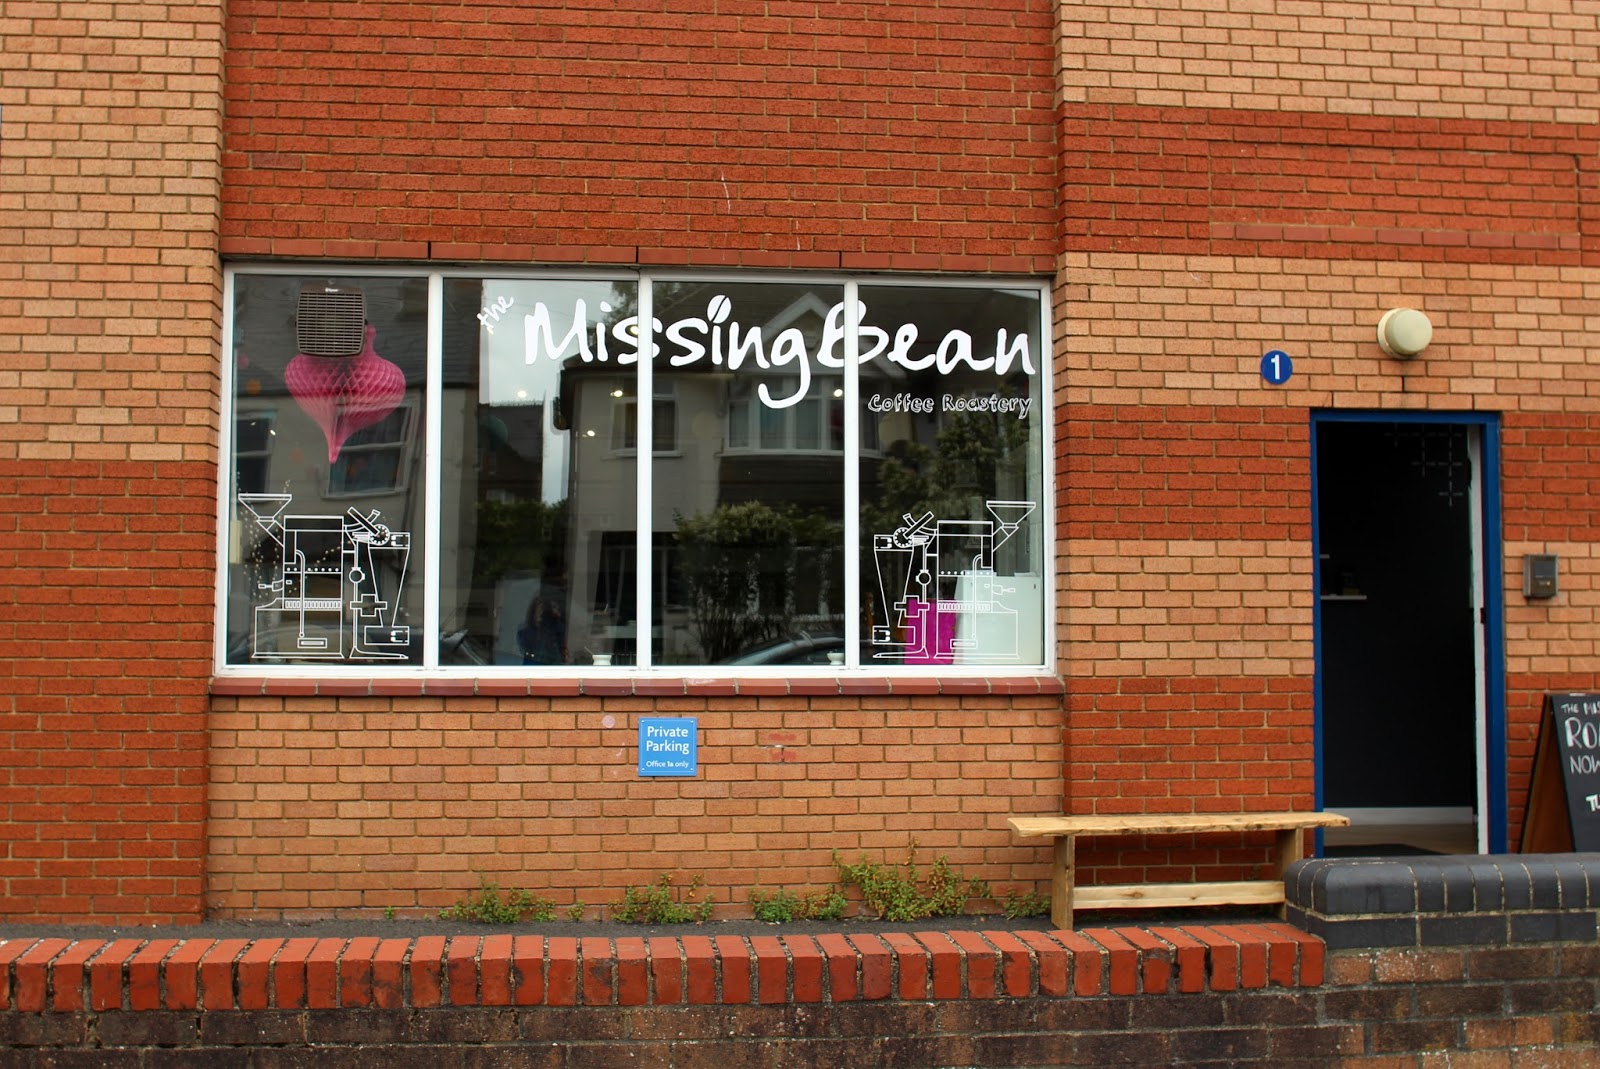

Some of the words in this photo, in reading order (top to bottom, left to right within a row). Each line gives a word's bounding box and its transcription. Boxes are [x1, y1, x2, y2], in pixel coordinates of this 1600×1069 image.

[477, 296, 515, 335] the
[524, 294, 812, 409] Missing
[816, 299, 1036, 376] Bean
[1270, 354, 1280, 380] 1
[868, 393, 935, 413] Coffee
[942, 393, 1033, 420] Roastery
[1560, 703, 1579, 714] THE
[647, 726, 689, 737] Private
[1564, 717, 1600, 749] RO
[646, 740, 690, 755] Parking
[675, 760, 689, 768] only
